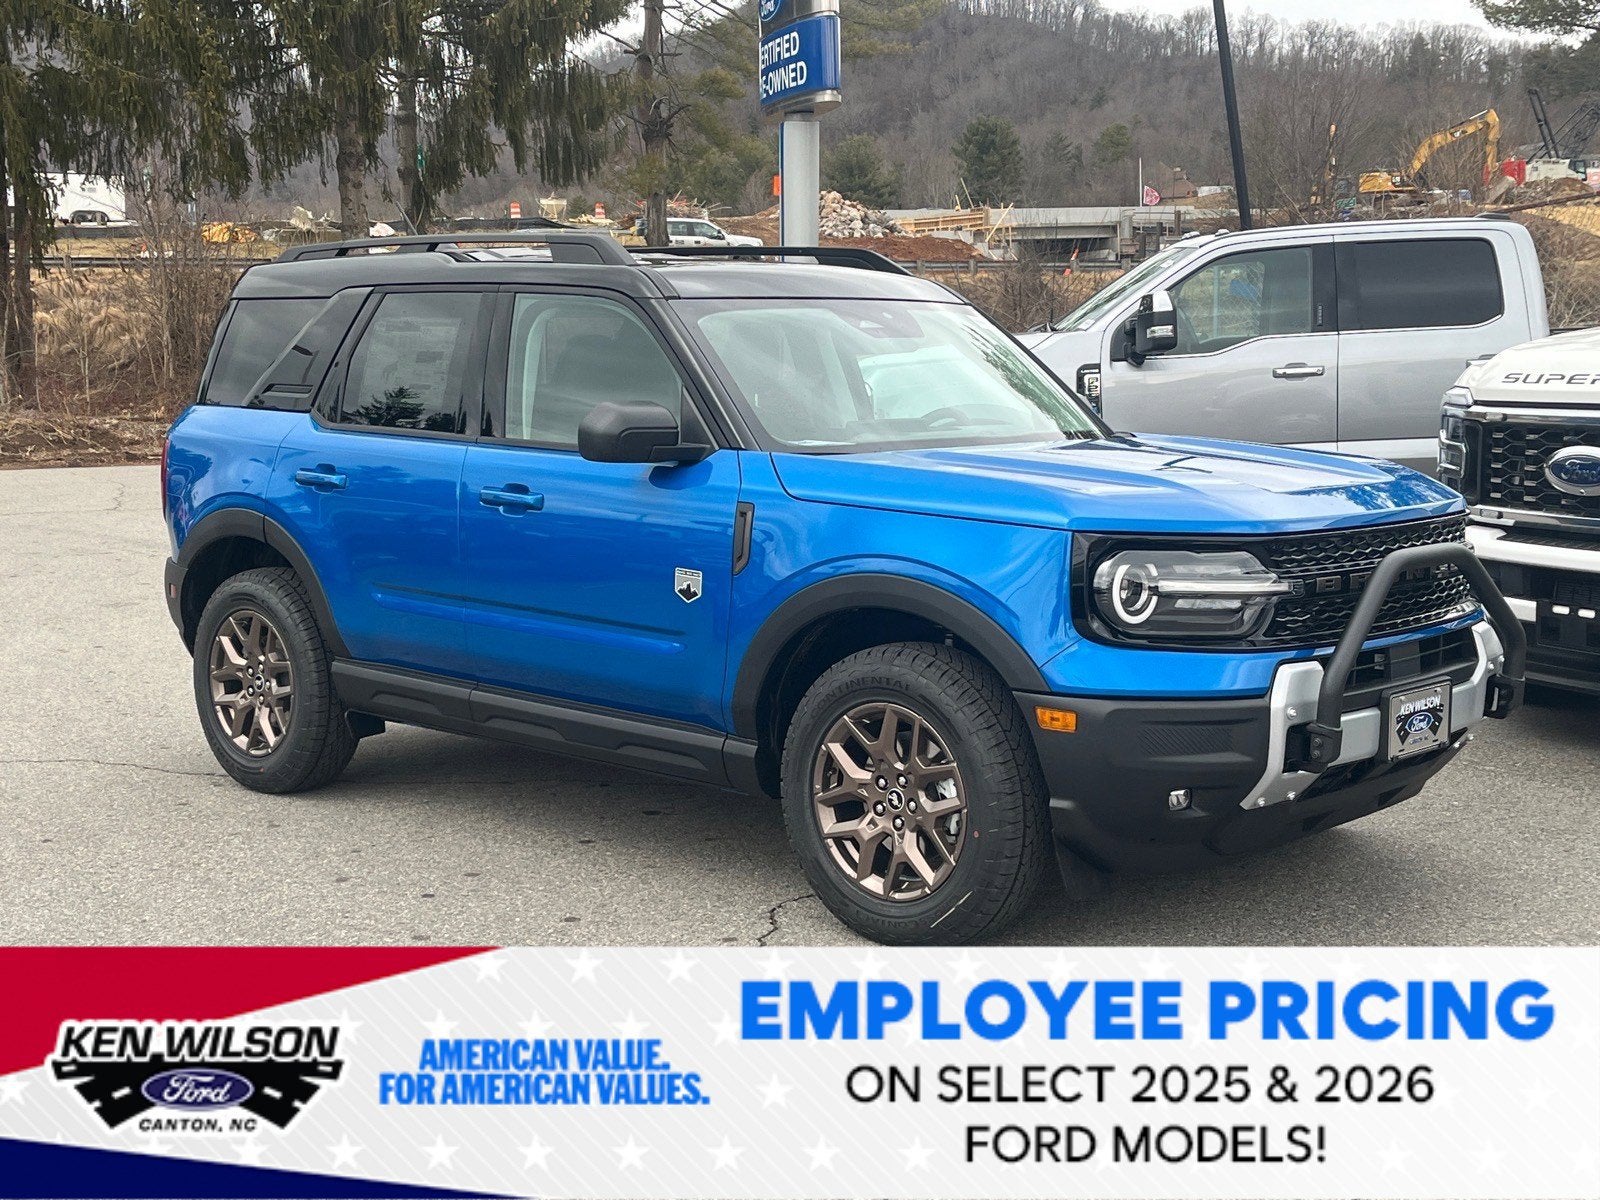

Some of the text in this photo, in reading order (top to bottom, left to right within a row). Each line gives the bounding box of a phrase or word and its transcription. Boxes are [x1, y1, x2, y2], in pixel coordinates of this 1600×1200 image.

[760, 31, 800, 70] ERTIFIED
[760, 60, 808, 99] E-OWNED
[1400, 694, 1441, 716] KEN WILSON
[1410, 715, 1429, 732] Ford
